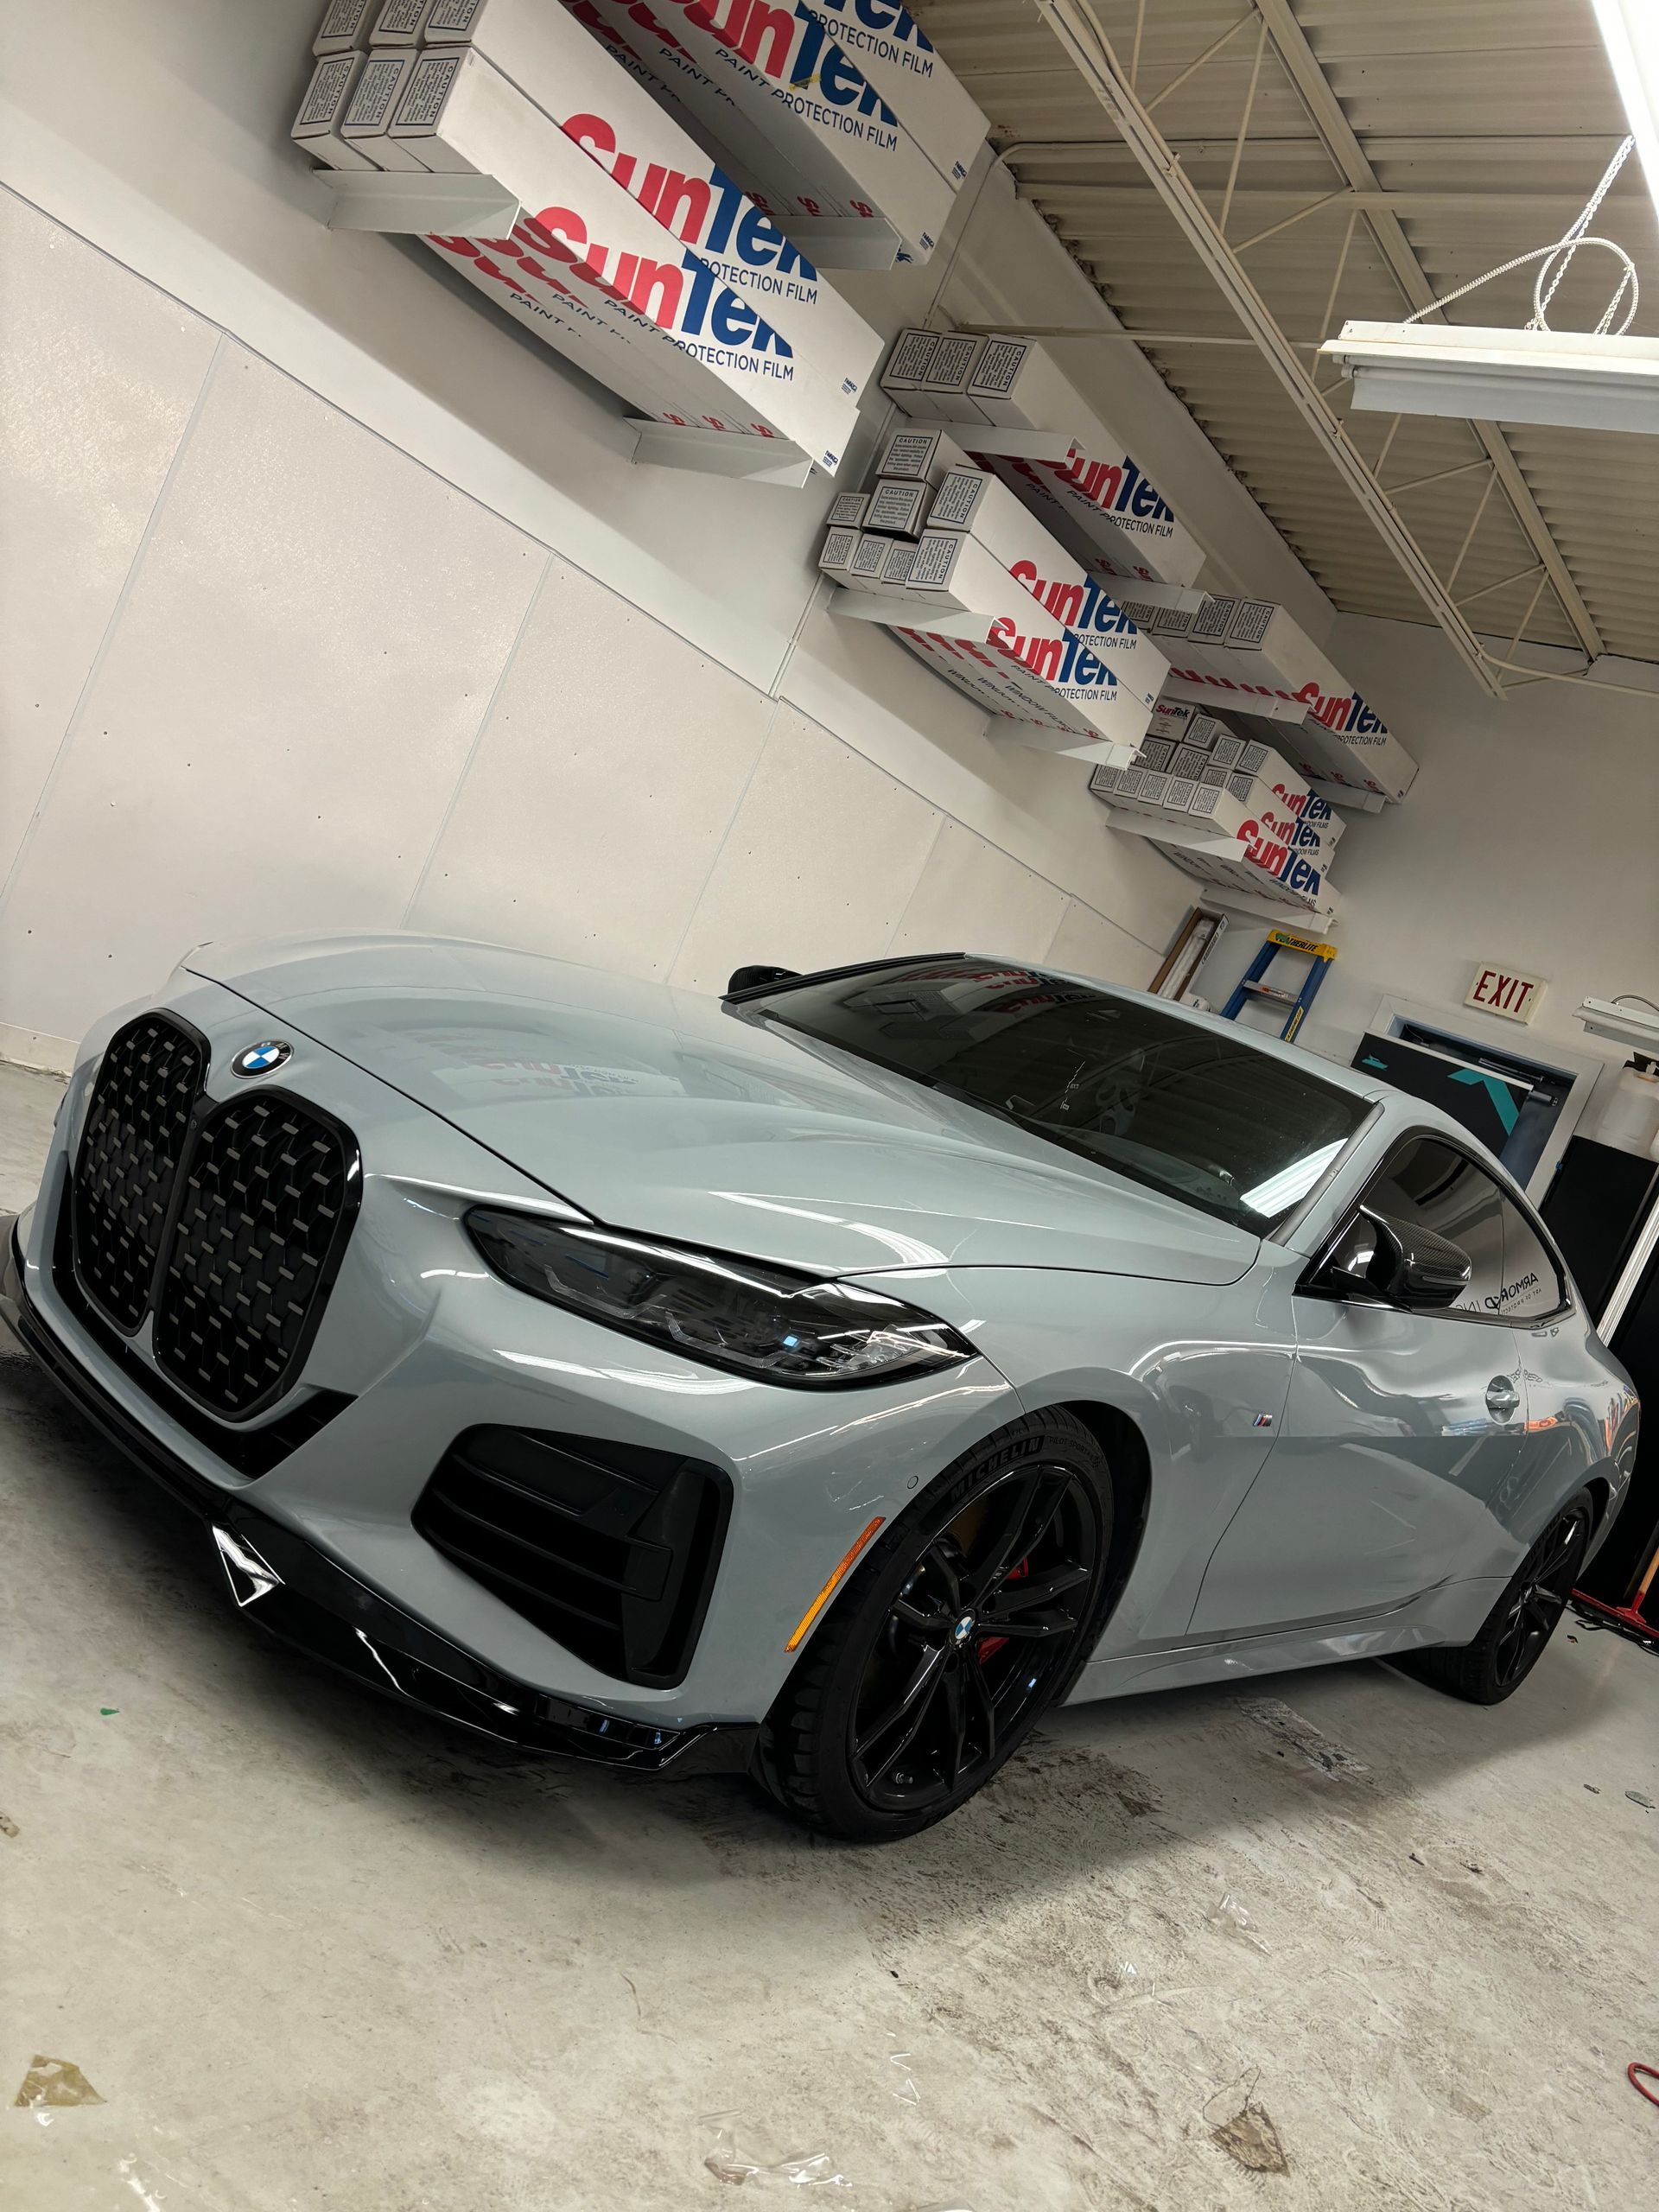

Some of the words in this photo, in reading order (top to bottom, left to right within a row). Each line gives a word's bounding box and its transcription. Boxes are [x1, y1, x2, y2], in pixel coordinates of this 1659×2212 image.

[658, 48, 714, 86] PAINT
[901, 51, 934, 78] FILM
[327, 65, 350, 118] CAUTION
[376, 67, 399, 119] CAUTION
[429, 65, 454, 118] CAUTION
[715, 48, 772, 87] PAINT
[771, 88, 864, 139] PROTECTION
[867, 125, 899, 152] FILM
[509, 292, 565, 325] PAINT
[551, 292, 608, 326] PAINT
[785, 284, 817, 304] FILM
[605, 298, 661, 334] PAINT
[661, 334, 760, 373] PROTECTION
[762, 361, 795, 381] FILM
[917, 341, 936, 377] CAUTION
[954, 346, 974, 381] CAUTION
[1002, 350, 1023, 387] CAUTION
[885, 489, 915, 498] CAUTION
[960, 483, 979, 519] CAUTION
[1027, 483, 1060, 505] PAINT
[1066, 490, 1103, 512] PAINT
[1099, 512, 1154, 535] PROTECTION
[1155, 524, 1174, 538] FILM
[938, 543, 955, 581] CAUTION
[1255, 610, 1271, 639] CAUTION
[1118, 638, 1137, 650] FILM
[1005, 684, 1046, 713] WINDOW
[1010, 664, 1046, 684] PAINT
[1100, 690, 1118, 702] FILM
[1155, 704, 1192, 718] SunTek
[1373, 736, 1388, 747] FILM
[1154, 747, 1168, 772] CAUTIO
[1276, 932, 1319, 952] THERLITE
[1473, 969, 1535, 1014] EXIT
[951, 1436, 1041, 1502] MICHELIN
